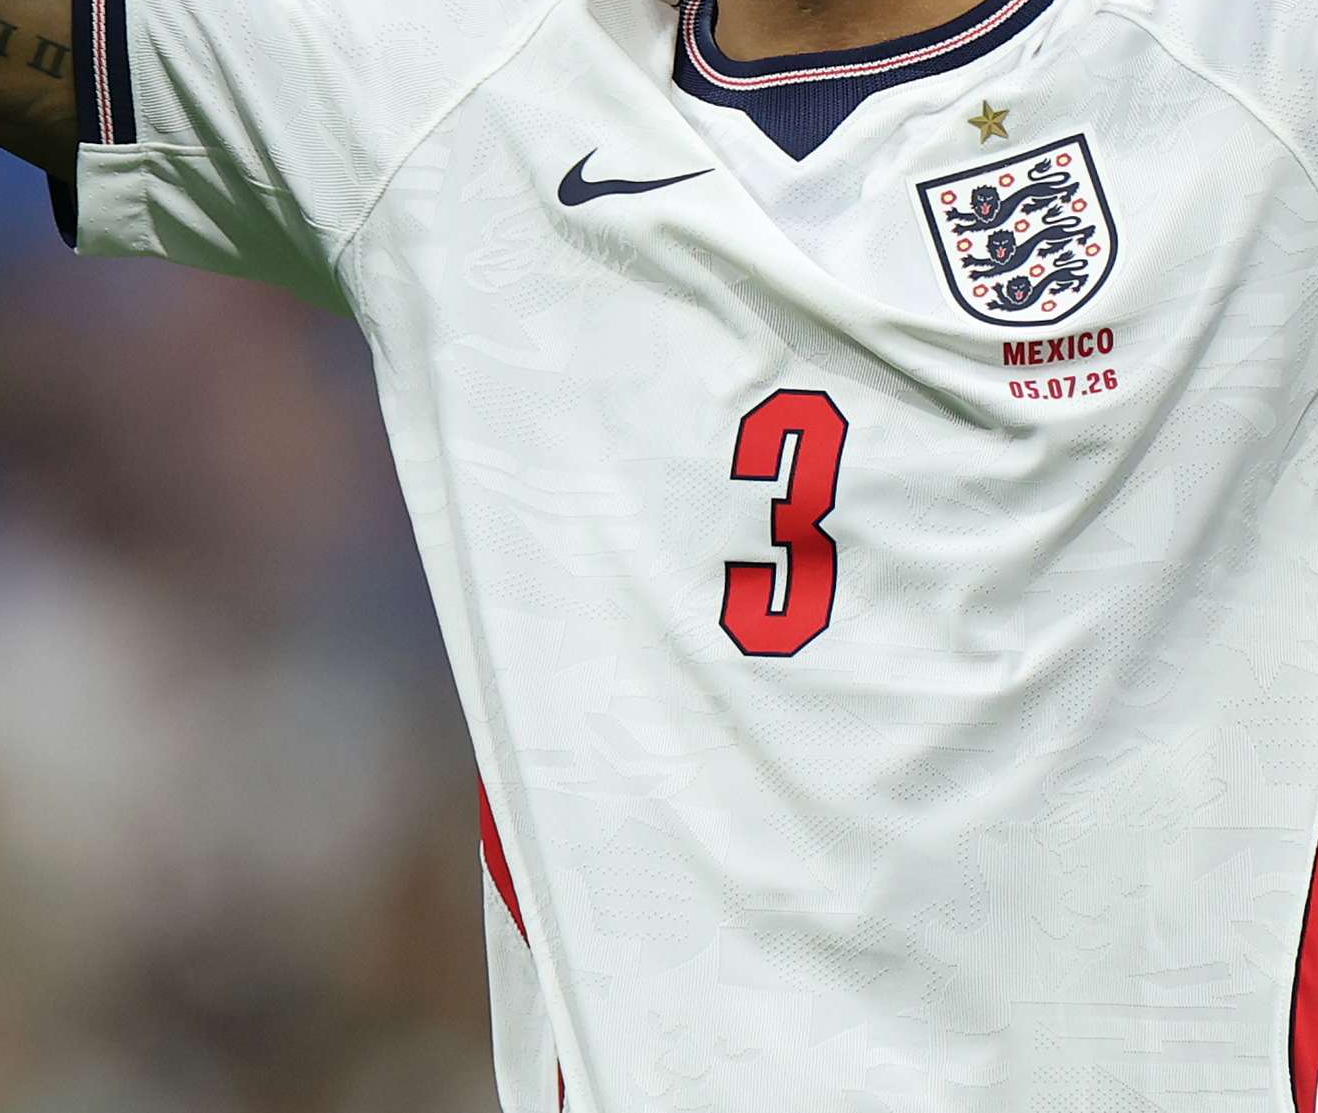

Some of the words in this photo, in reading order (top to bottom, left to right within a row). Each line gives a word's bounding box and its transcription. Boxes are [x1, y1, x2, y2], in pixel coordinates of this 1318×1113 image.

[1003, 327, 1115, 366] MEXICO
[1009, 368, 1119, 400] 05.07.26
[718, 388, 849, 658] 3
